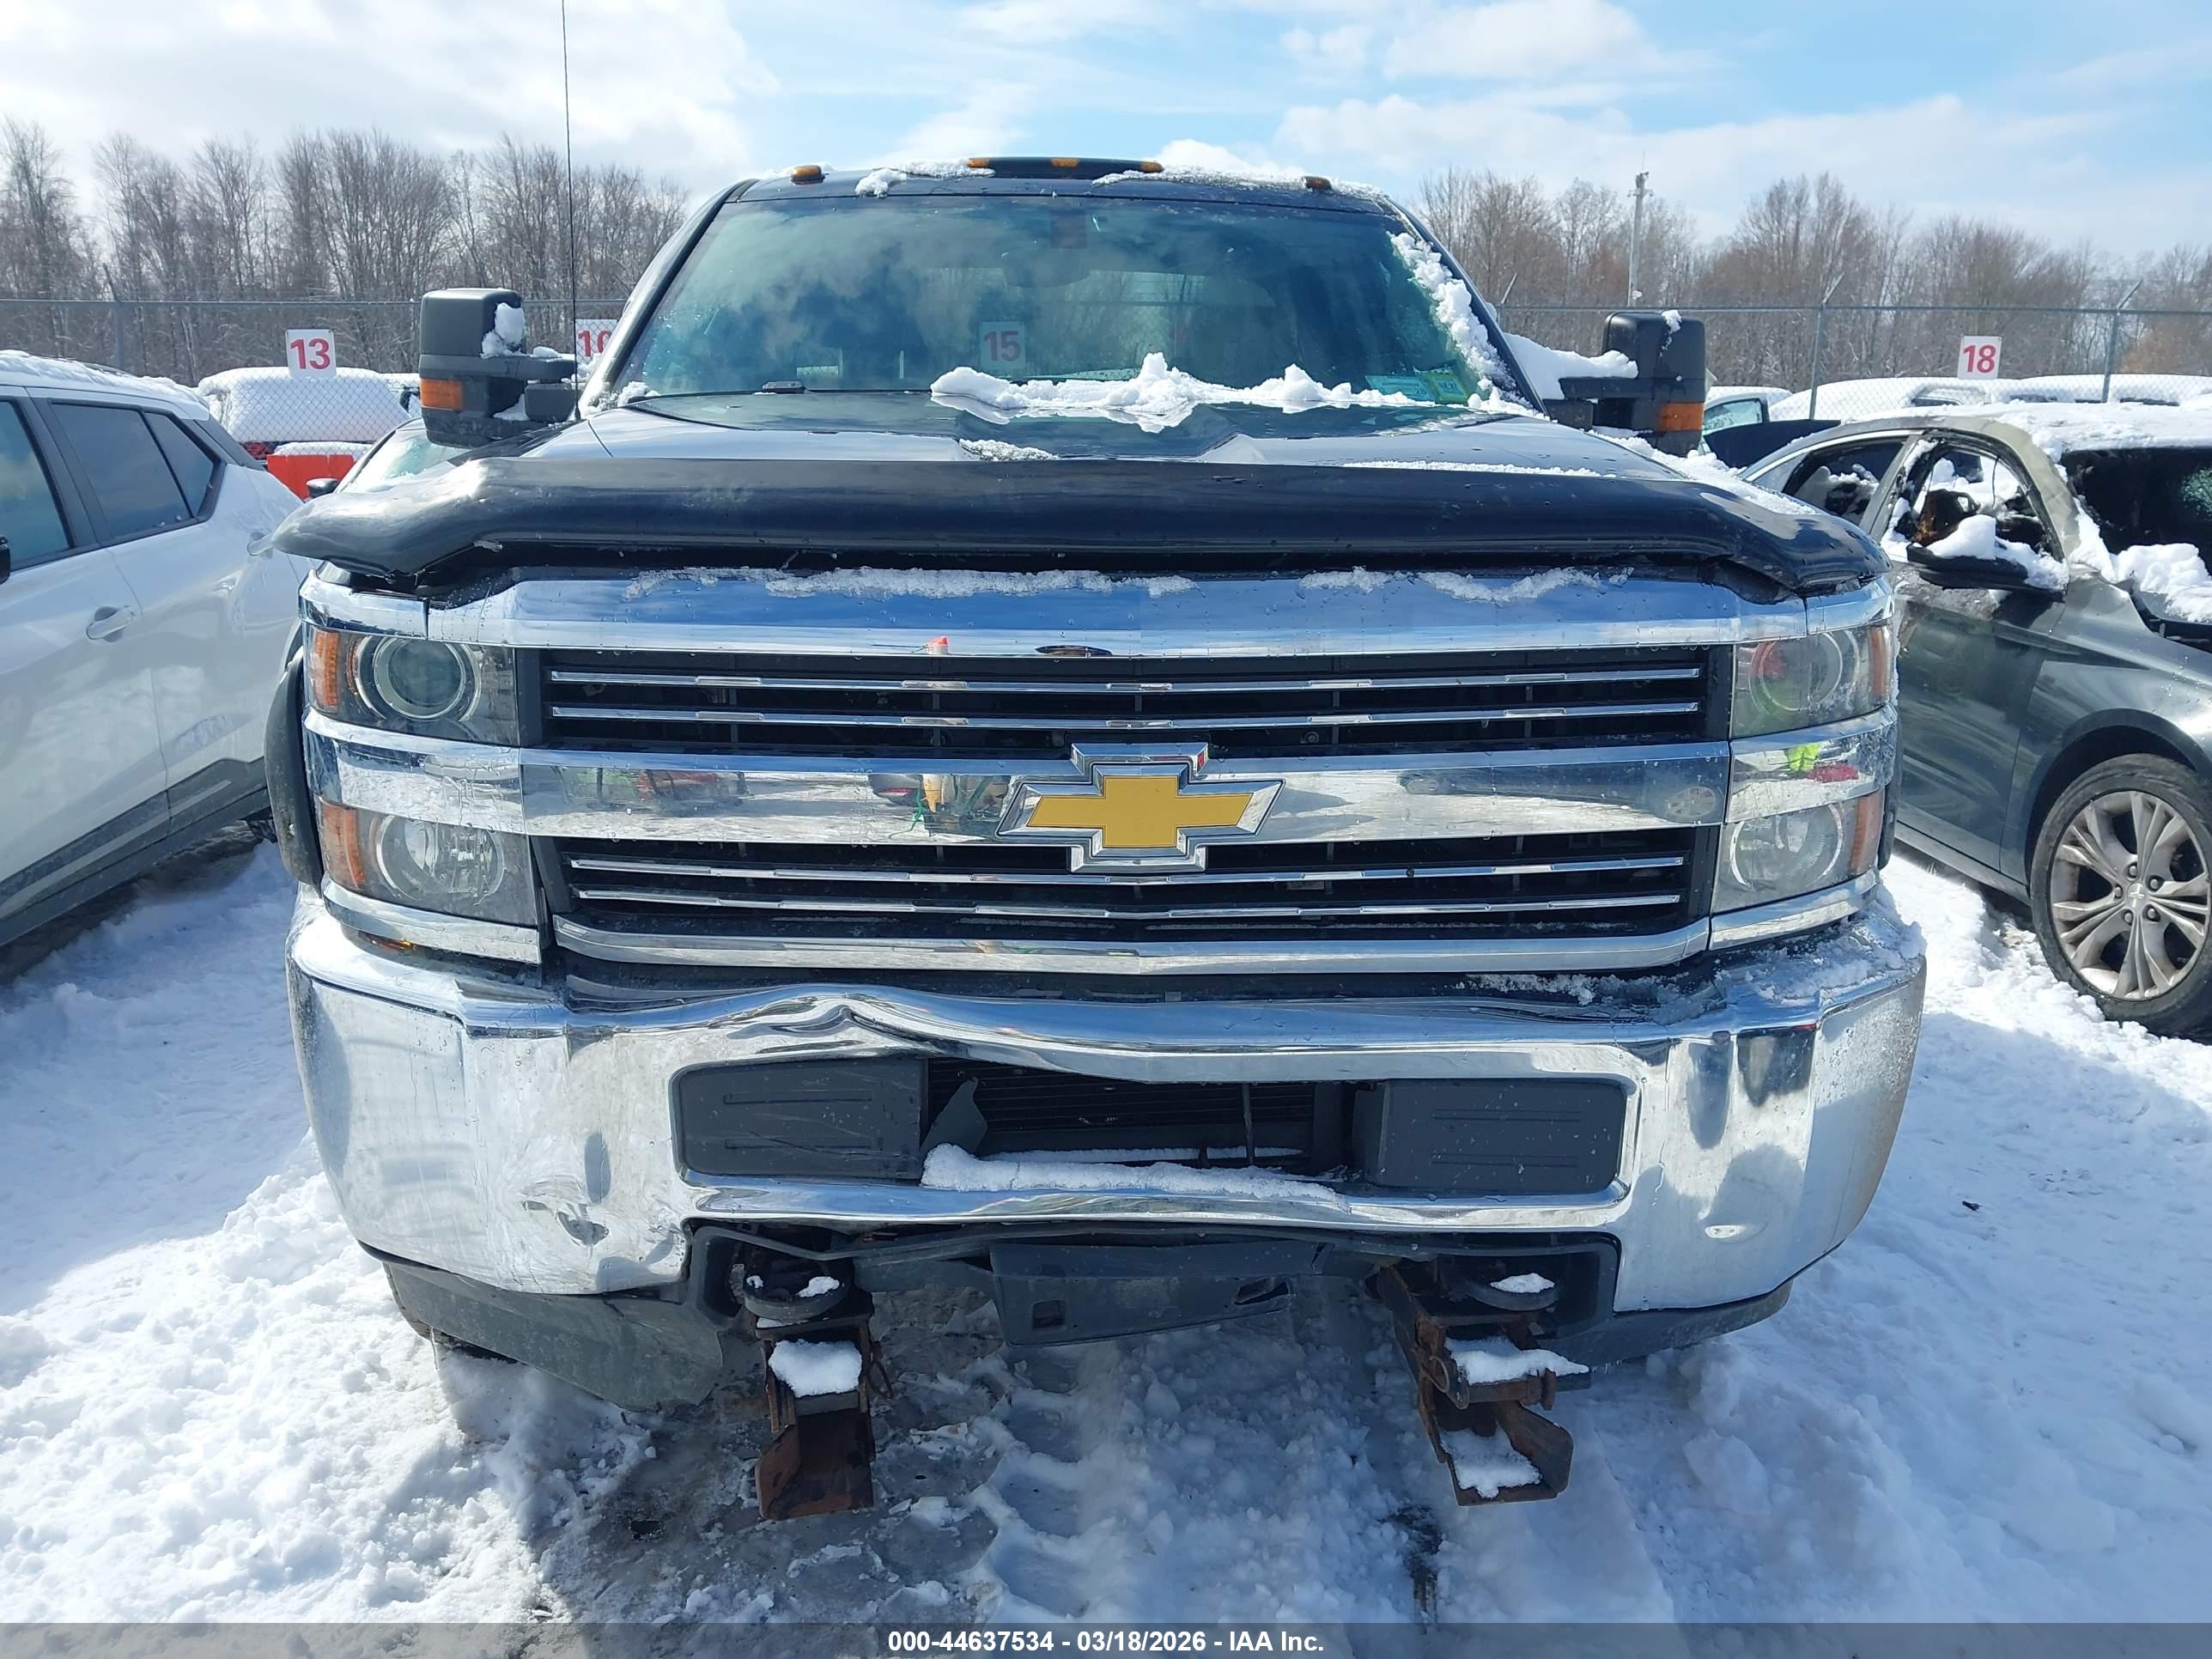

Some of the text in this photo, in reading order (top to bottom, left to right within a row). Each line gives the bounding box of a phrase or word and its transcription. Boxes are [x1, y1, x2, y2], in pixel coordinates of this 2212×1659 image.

[290, 338, 331, 369] 13
[983, 330, 1022, 362] 15
[1963, 344, 1996, 374] 18
